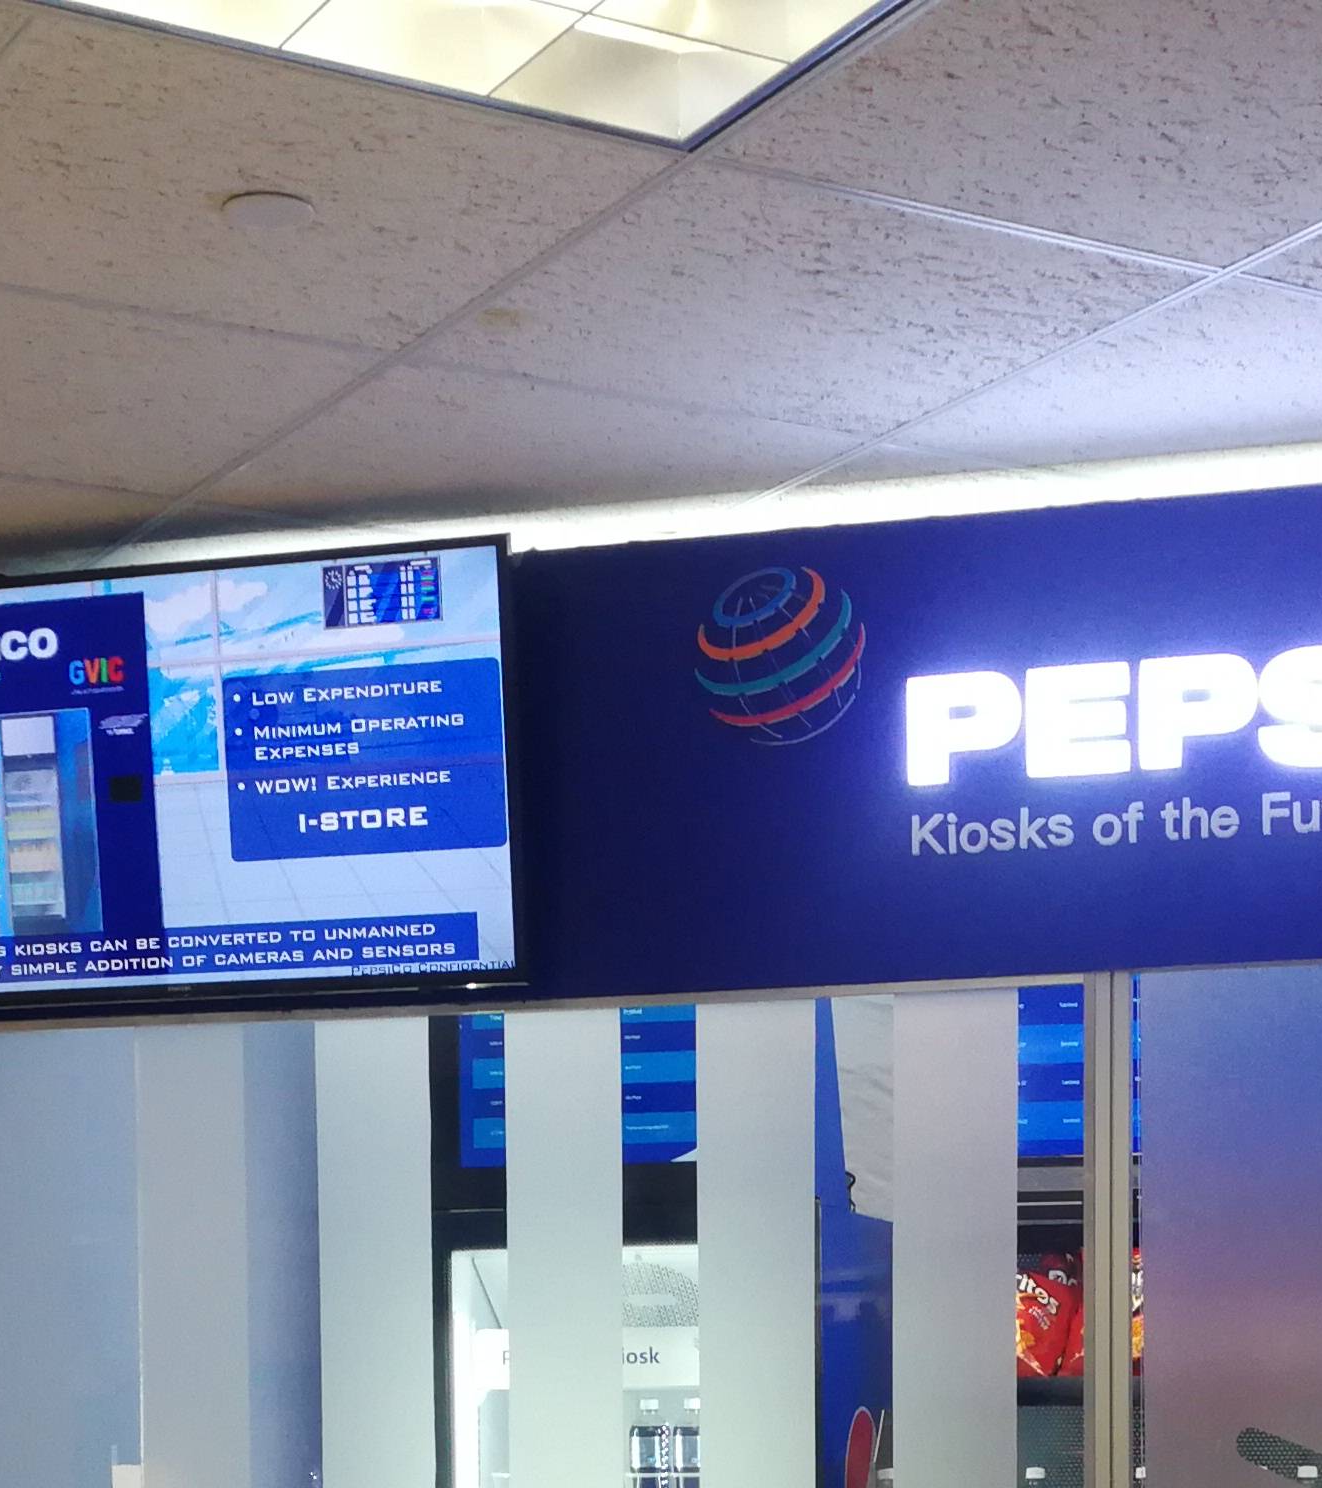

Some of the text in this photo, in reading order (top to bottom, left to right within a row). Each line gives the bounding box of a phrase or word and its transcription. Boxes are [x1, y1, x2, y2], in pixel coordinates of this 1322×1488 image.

[69, 656, 124, 686] GVIC
[255, 778, 317, 794] WOW!
[298, 806, 428, 833] I-STORE
[909, 806, 1074, 857] Kiosks
[1093, 804, 1144, 846] of
[1163, 799, 1238, 840] the
[14, 941, 82, 957] KIOSKS
[90, 938, 128, 953] CAN
[136, 937, 160, 950] BE
[168, 931, 282, 949] CONVERTED
[290, 929, 314, 942] TO
[324, 923, 436, 941] UNMANNED
[11, 961, 77, 976] SIMPLE
[85, 957, 173, 974] ADDITION
[182, 955, 206, 968] OF
[214, 950, 304, 967] CAMERAS
[312, 947, 353, 962] AND
[362, 942, 456, 959] SENSORS
